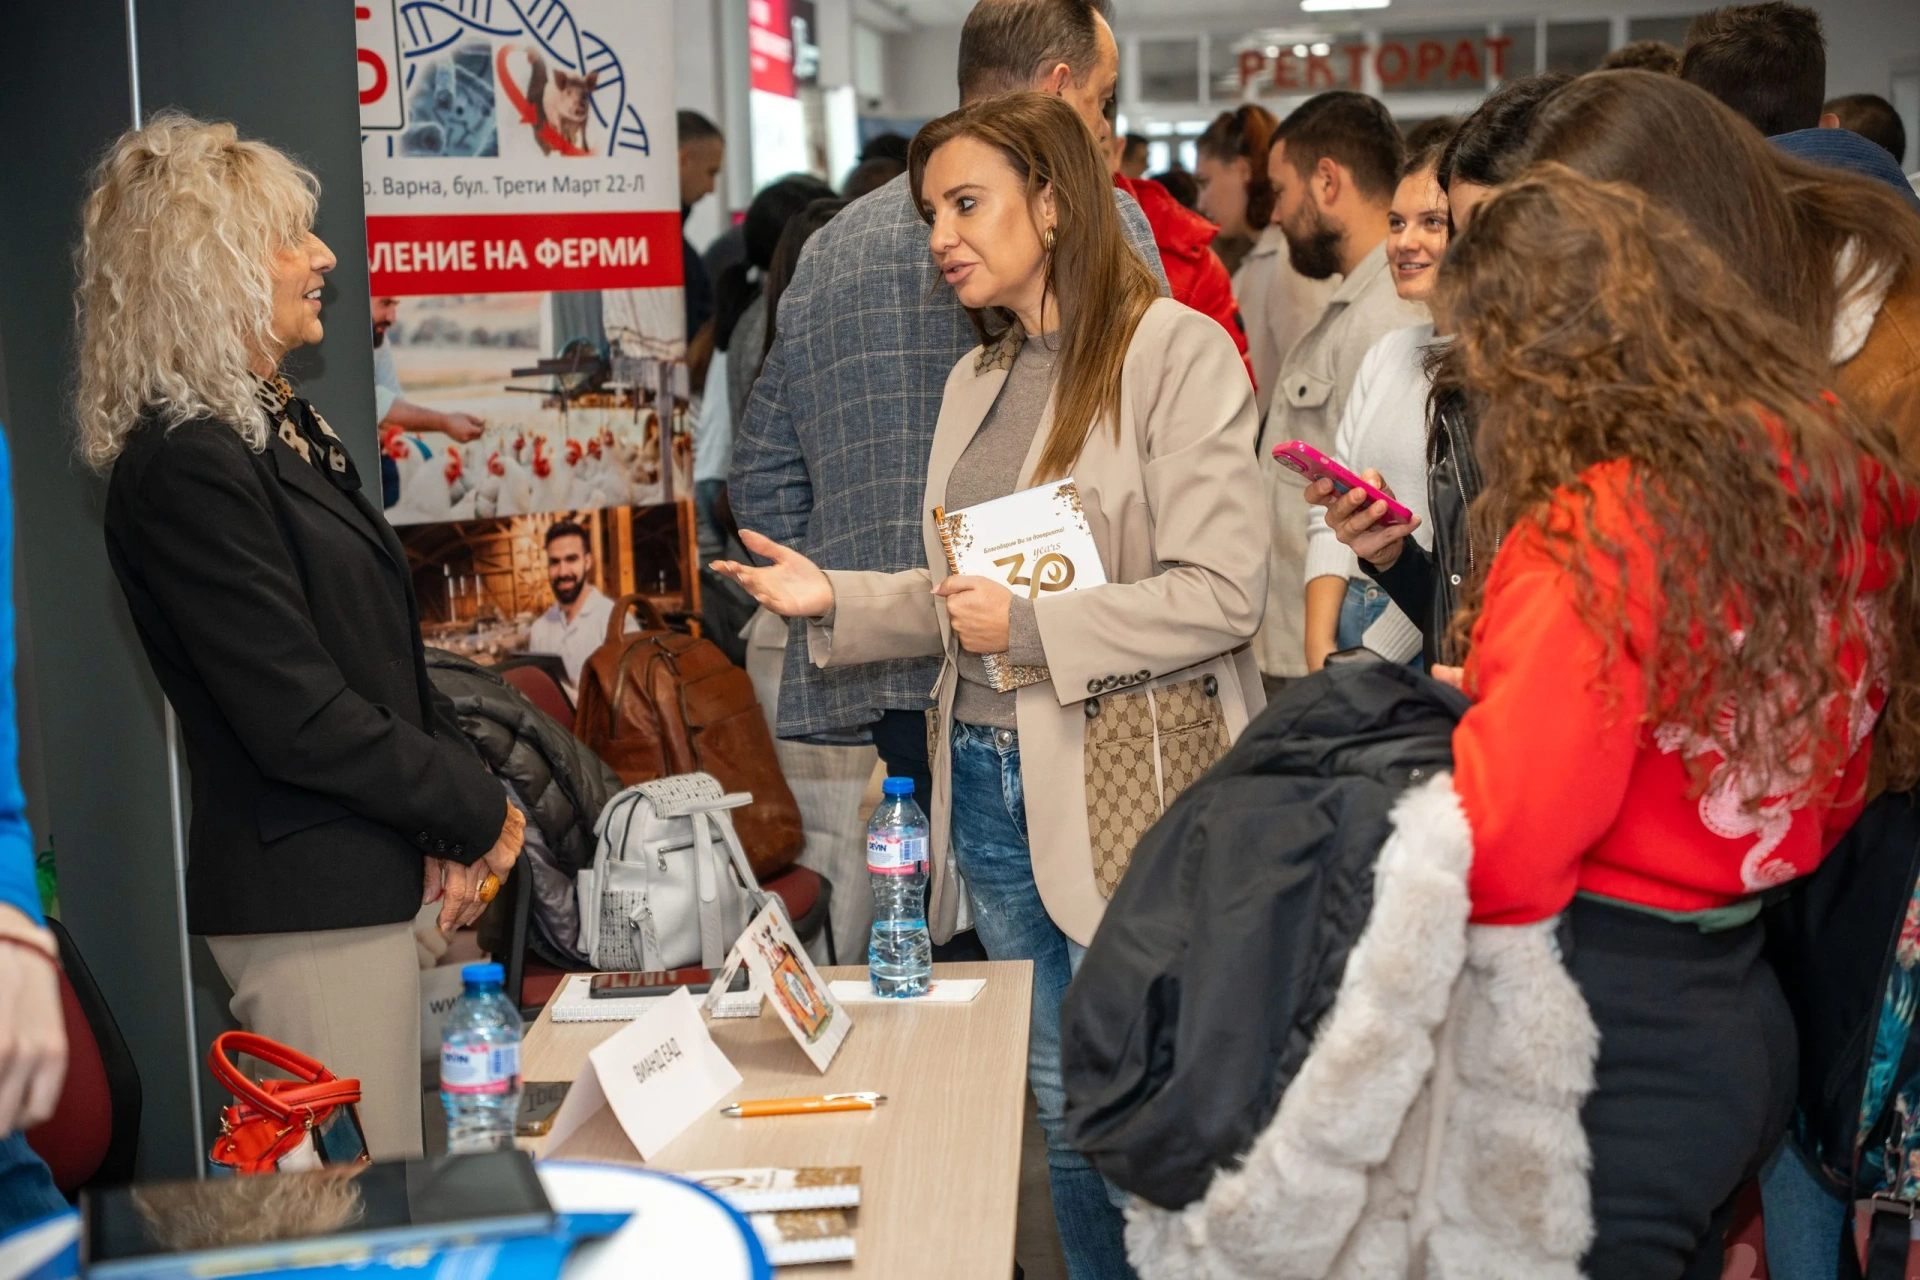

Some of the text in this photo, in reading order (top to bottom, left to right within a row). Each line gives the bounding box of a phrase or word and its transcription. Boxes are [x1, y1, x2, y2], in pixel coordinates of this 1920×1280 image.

[1238, 38, 1513, 89] РЕКТОРАТ
[383, 176, 447, 199] Варна,
[453, 175, 489, 198] бул.
[493, 175, 546, 199] Трети
[552, 175, 601, 197] Март
[606, 174, 645, 193] 22-Л
[369, 236, 649, 273] ЛЕНИЕ НА ФЕРМИ
[1033, 542, 1061, 562] years
[632, 1036, 684, 1084] ВИАНД ЕАД
